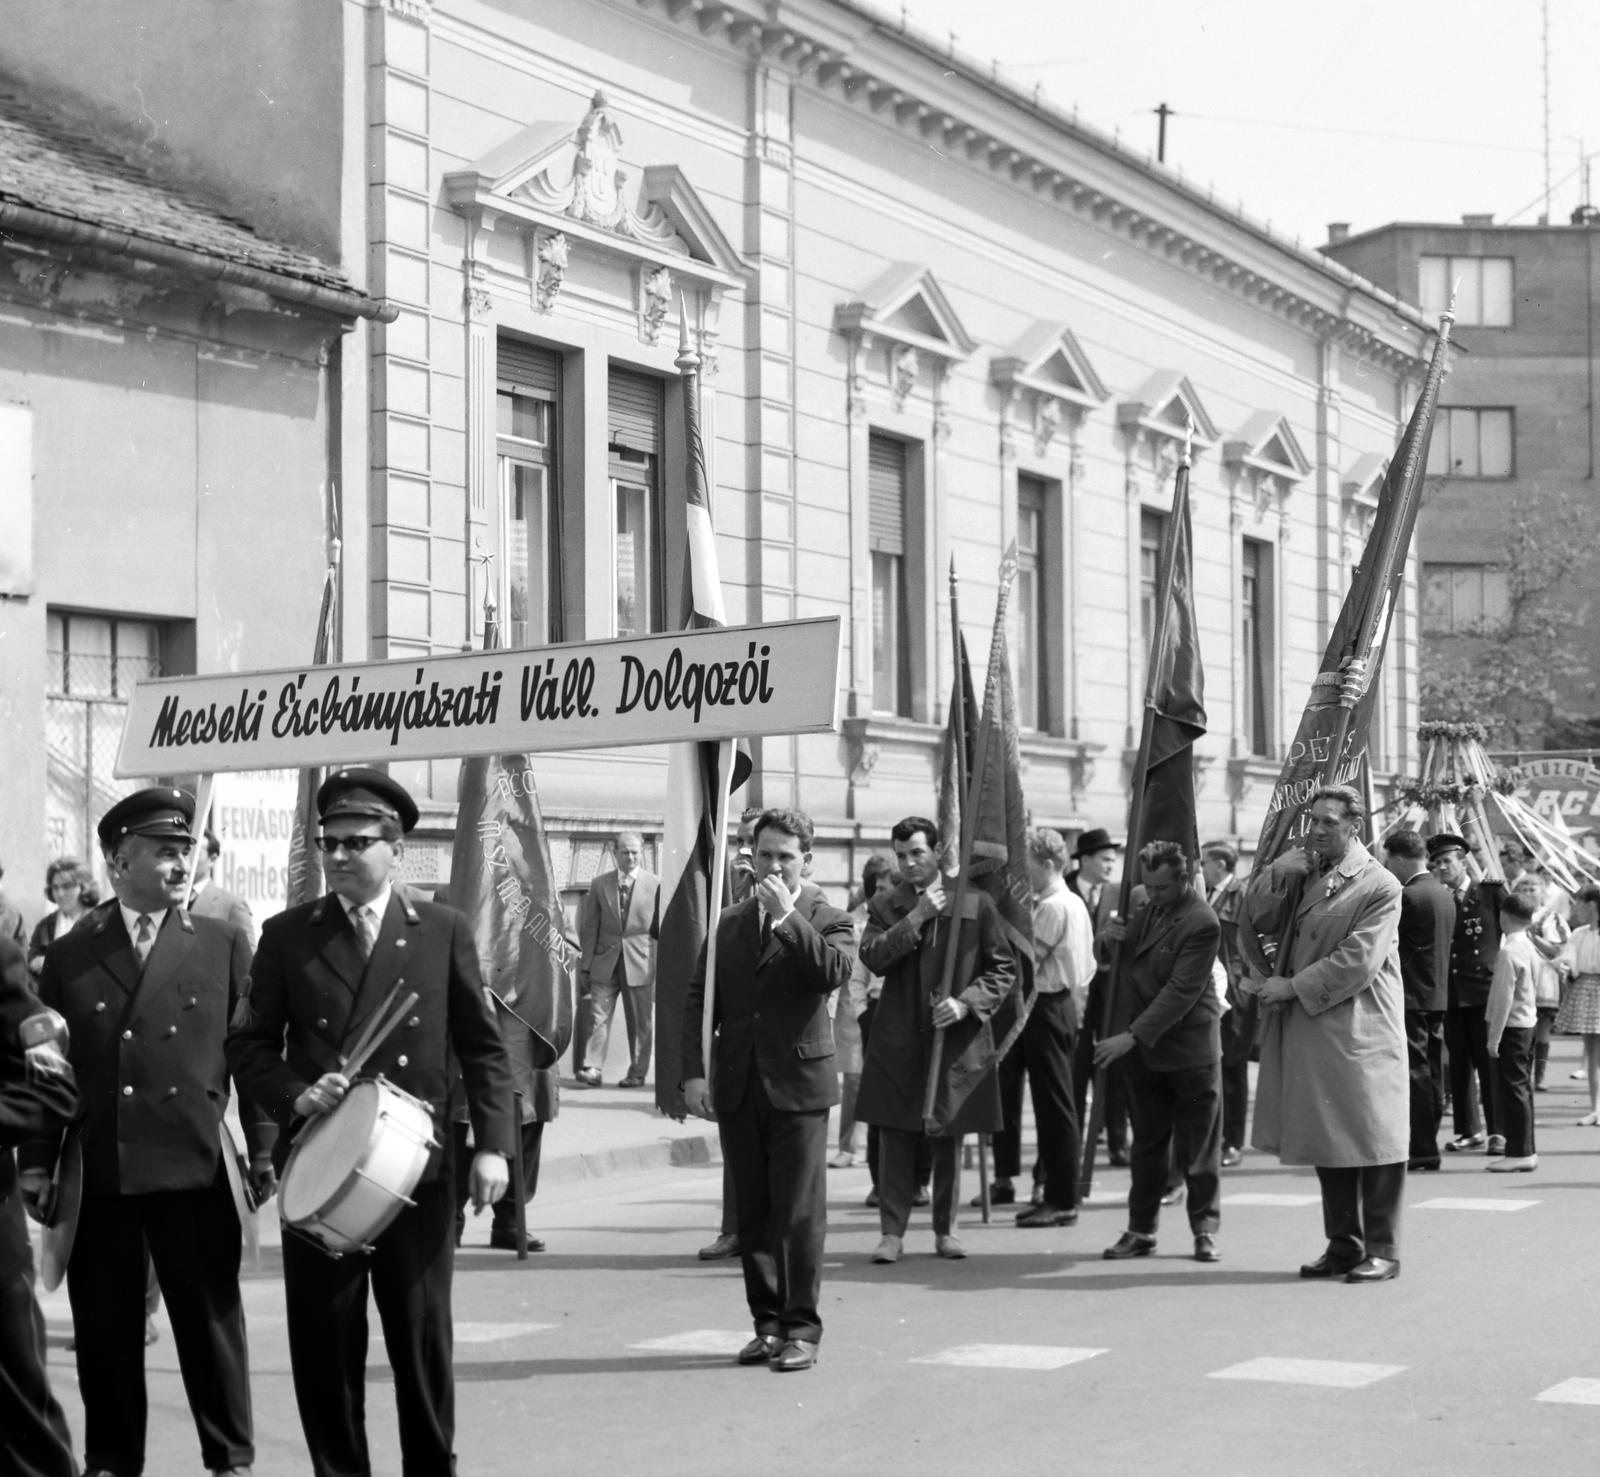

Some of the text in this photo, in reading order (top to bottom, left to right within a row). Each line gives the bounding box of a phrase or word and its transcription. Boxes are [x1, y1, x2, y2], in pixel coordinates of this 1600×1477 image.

[149, 642, 774, 748] Mecseki Ércbányászati Váll. Dolgozói
